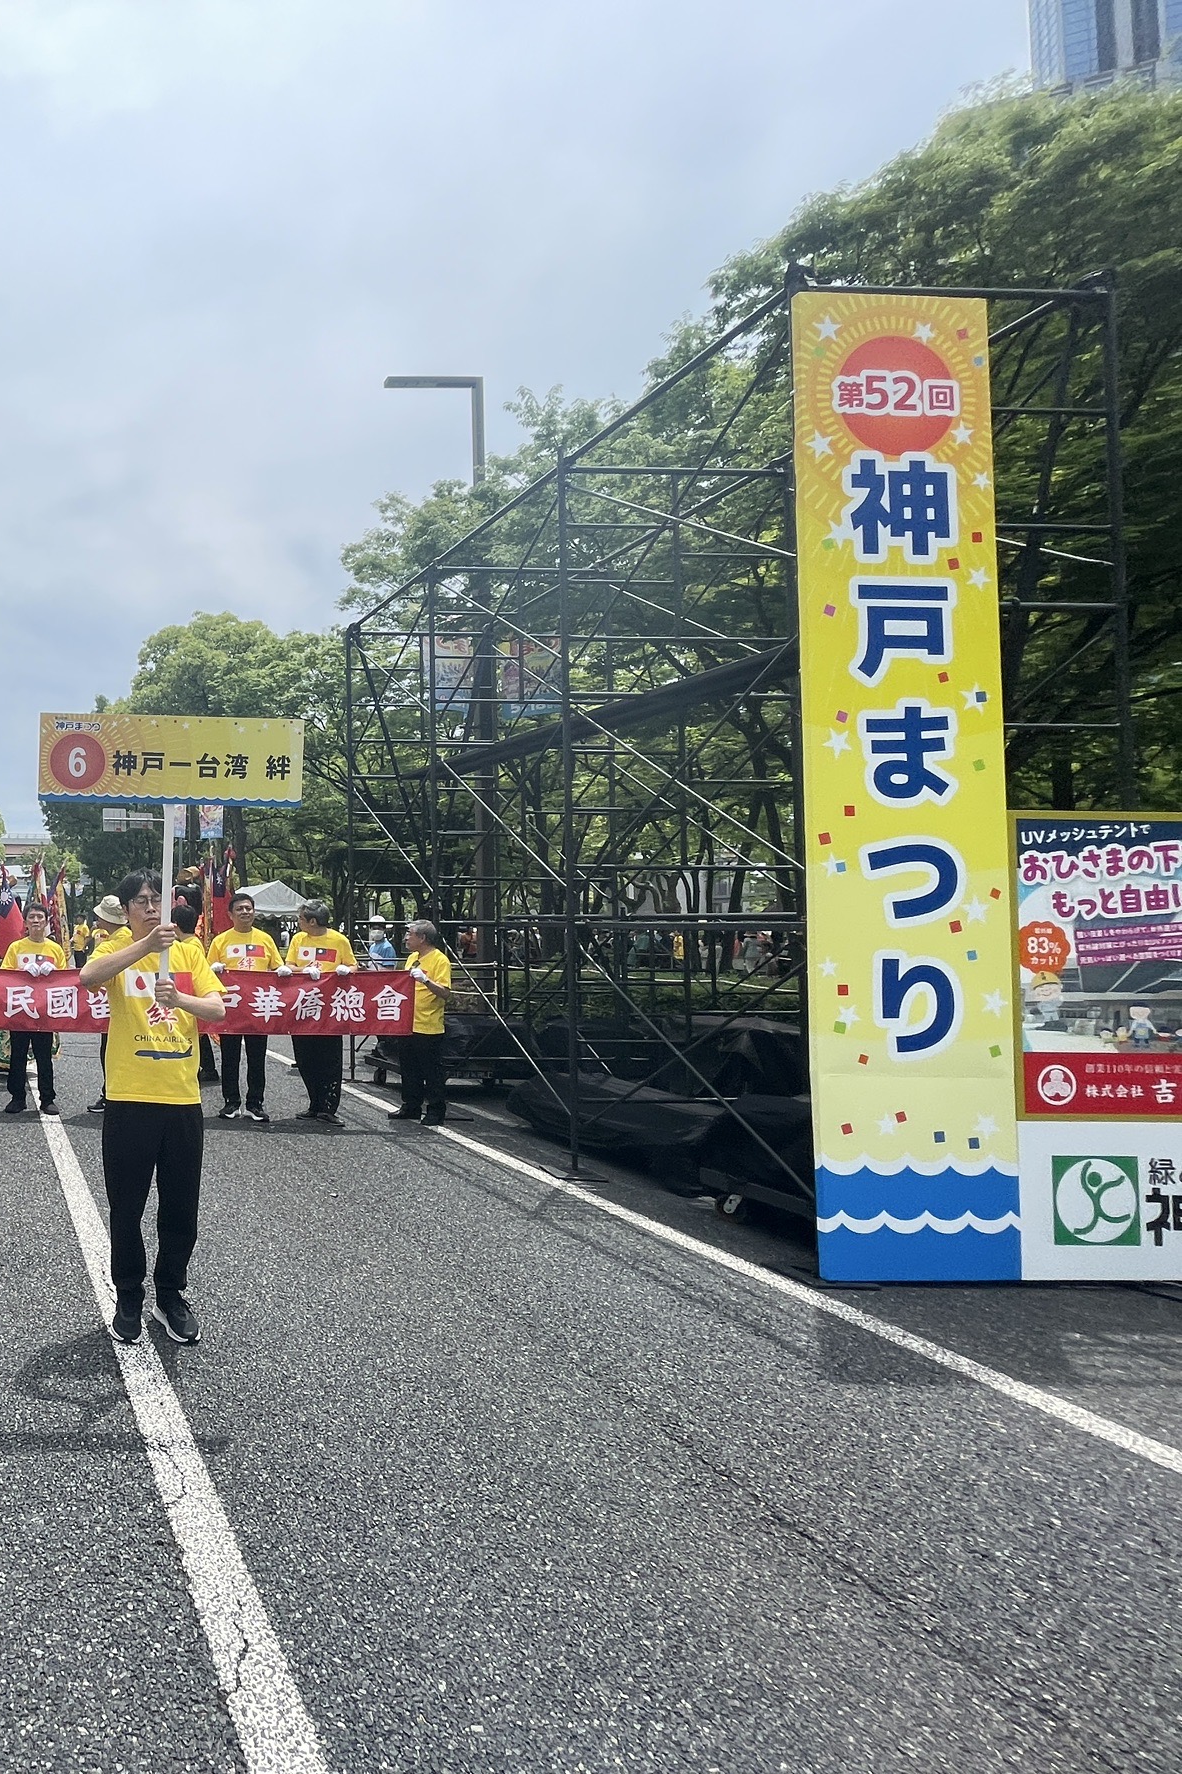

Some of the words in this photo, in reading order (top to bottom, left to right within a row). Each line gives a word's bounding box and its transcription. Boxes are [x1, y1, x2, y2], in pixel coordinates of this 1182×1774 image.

[837, 375, 955, 412] 第52回
[54, 721, 101, 731] 神戸まつり
[69, 747, 87, 778] 6
[265, 755, 291, 780] 絆
[850, 458, 958, 1054] 神戸まつり
[1021, 823, 1152, 845] UVメッシュテントで
[1022, 843, 1180, 882] おひさまの下
[1027, 936, 1062, 955] 83%
[134, 1034, 162, 1043] CHINA
[1085, 1084, 1145, 1099] 株式会社
[1151, 1078, 1178, 1104] 吉
[1148, 1157, 1182, 1186] 緑
